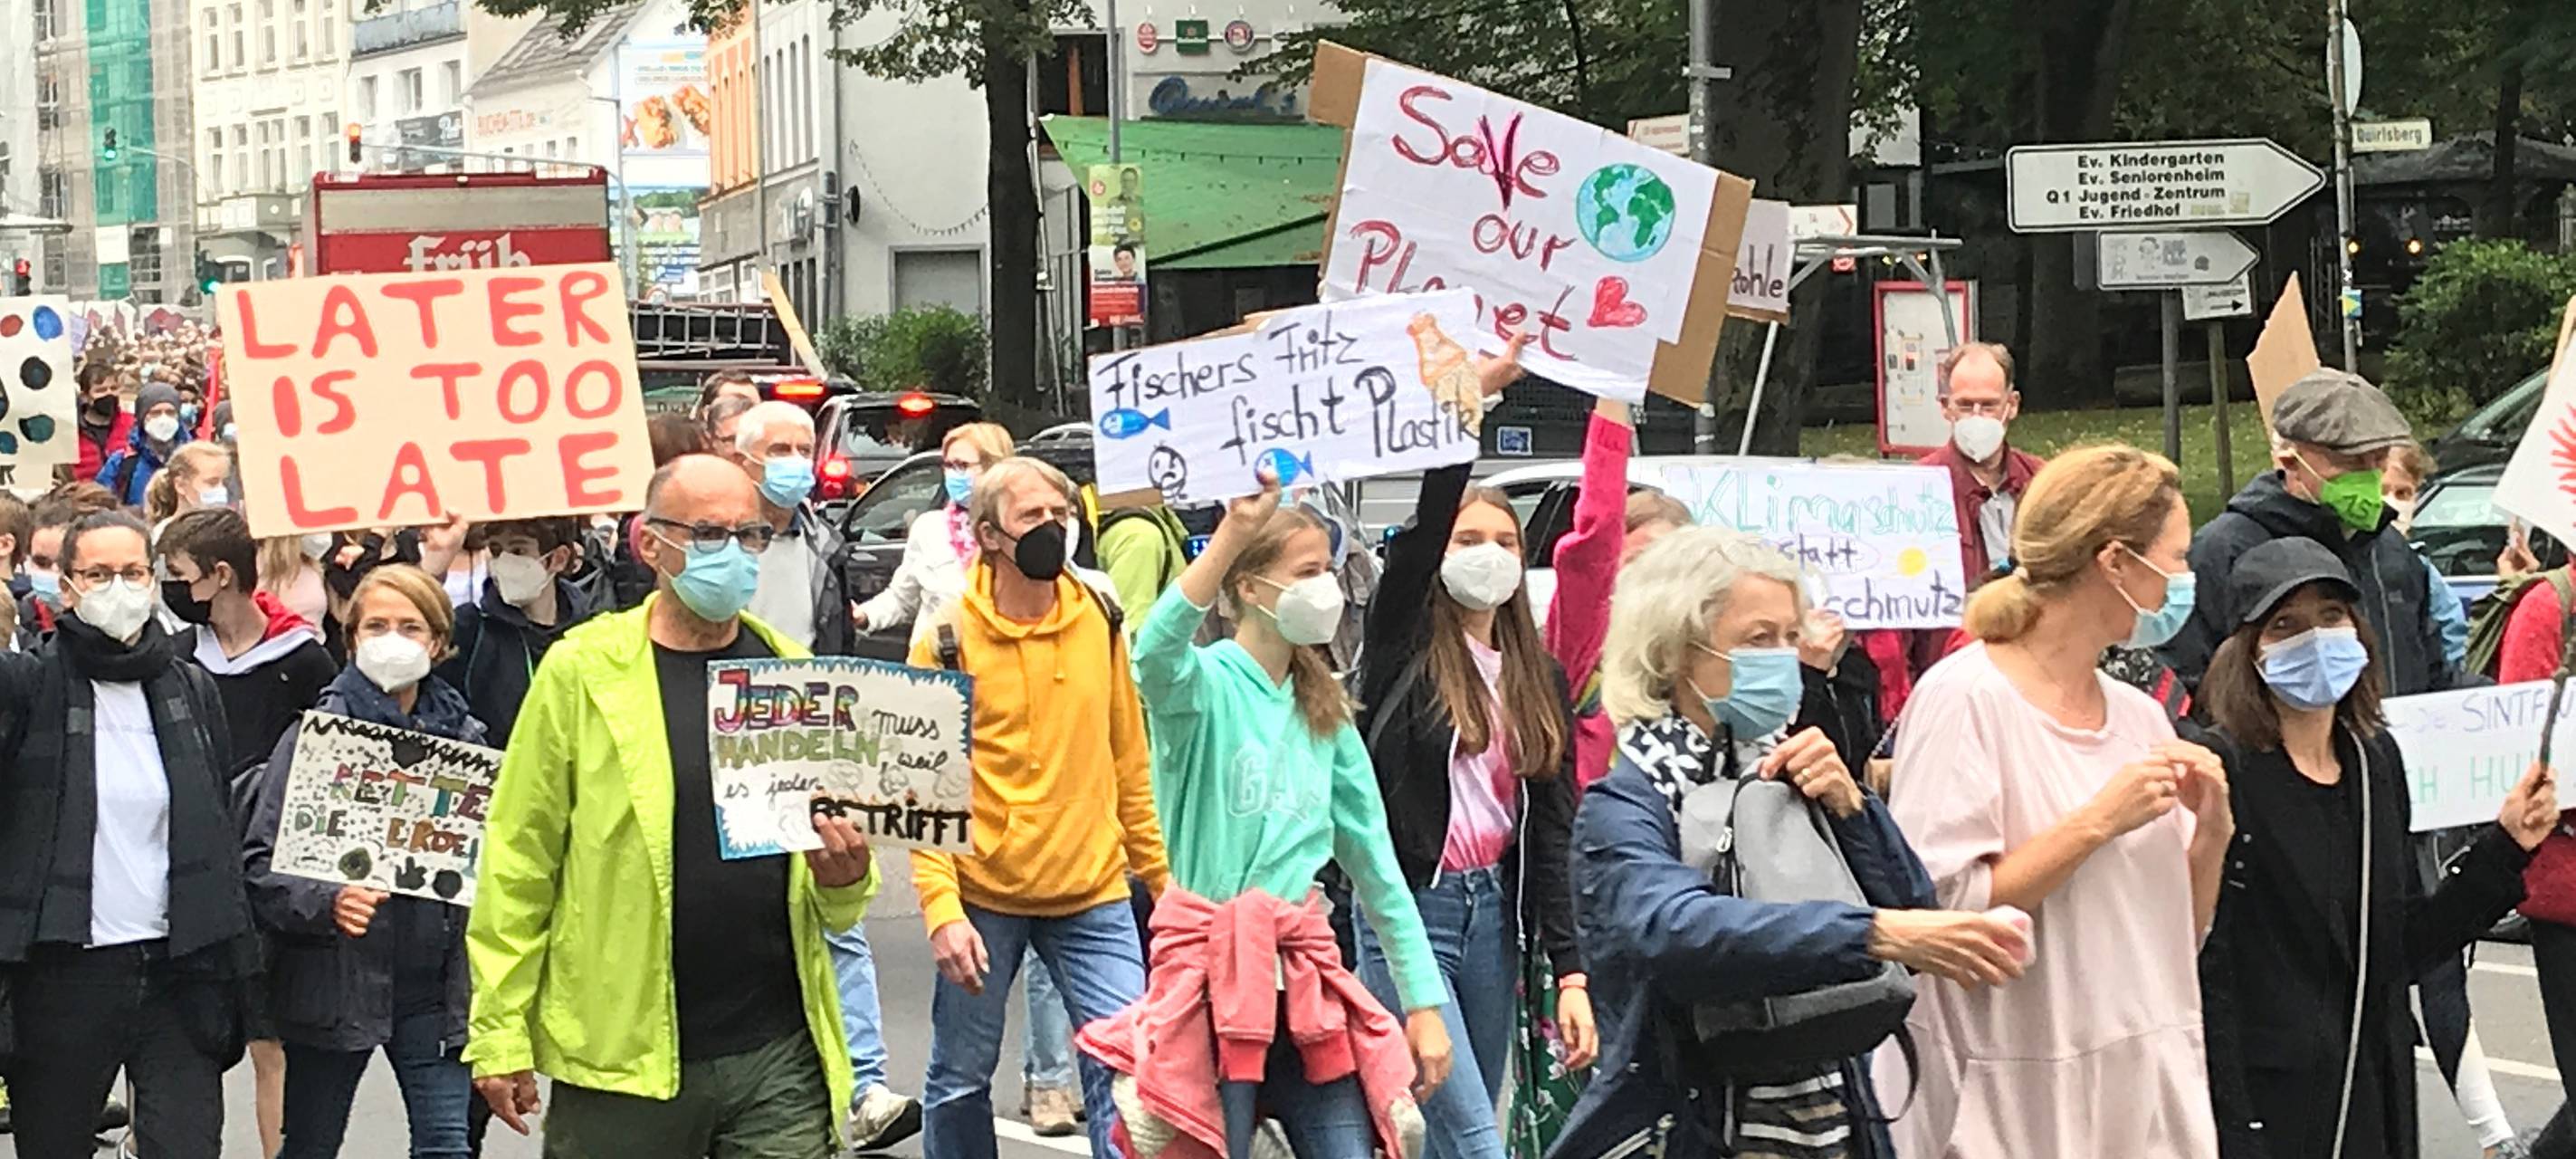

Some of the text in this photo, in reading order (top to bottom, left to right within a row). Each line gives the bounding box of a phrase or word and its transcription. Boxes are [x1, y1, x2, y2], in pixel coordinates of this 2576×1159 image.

[2077, 151, 2225, 169] Ev. Kindergarten
[2077, 168, 2226, 186] Ev. Seniorenheim
[2078, 206, 2105, 220] Ev.
[2110, 201, 2181, 219] Friedhof
[1472, 213, 1578, 272] our
[235, 270, 612, 359] LATER
[1097, 309, 1365, 410] Fischers Fritz
[272, 359, 624, 438] IS TOO
[1219, 375, 1347, 466] fischt
[279, 430, 624, 529] LATE
[714, 668, 940, 741] JEDER muss
[329, 762, 494, 822] RETTE
[724, 781, 749, 799] es
[897, 750, 949, 774] weil
